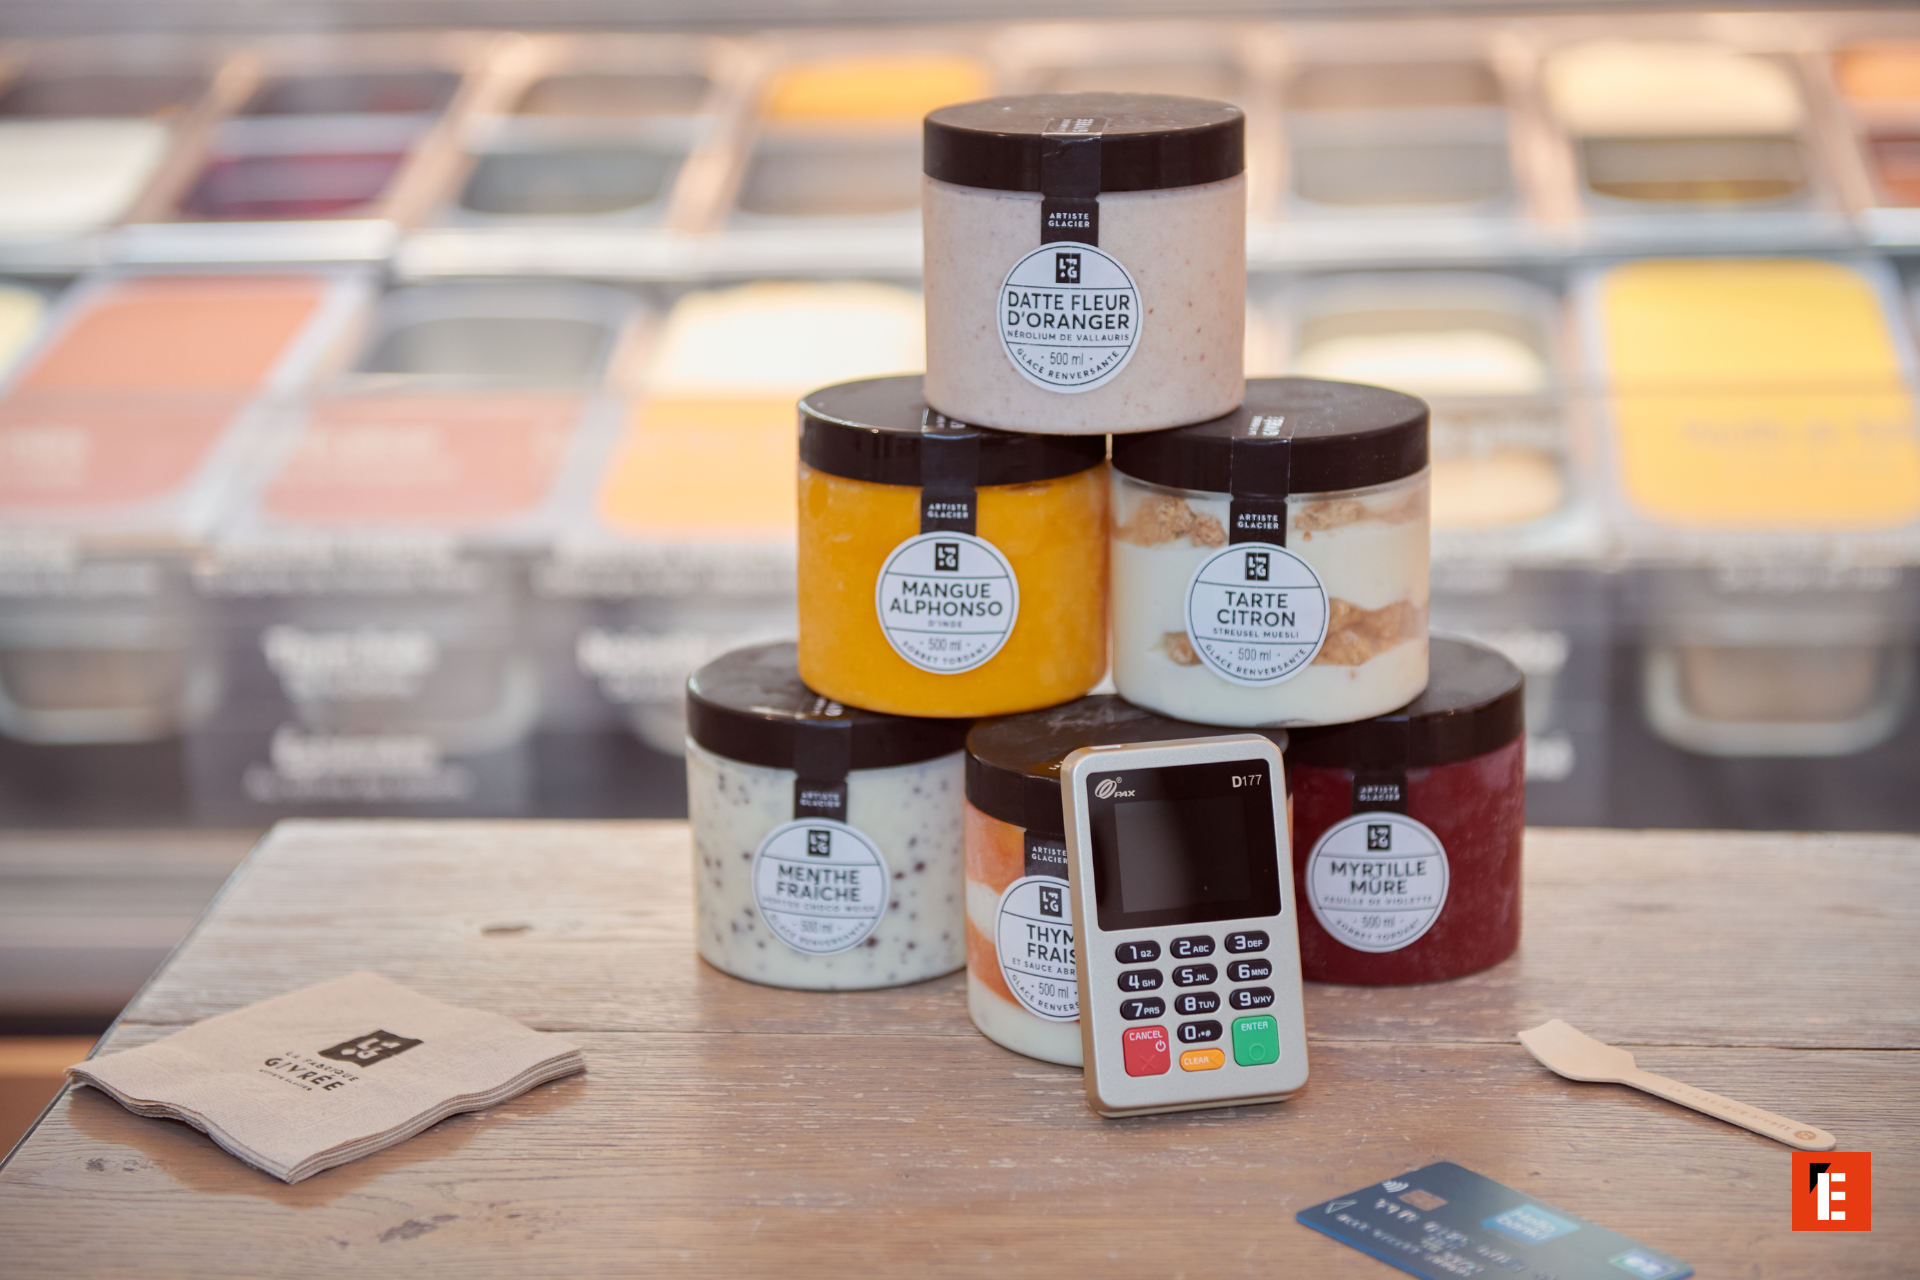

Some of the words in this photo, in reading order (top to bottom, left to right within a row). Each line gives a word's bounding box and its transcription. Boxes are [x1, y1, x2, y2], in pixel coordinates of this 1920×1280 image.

[1050, 212, 1089, 220] ARTISTE
[1048, 220, 1090, 228] GLACIER
[1008, 291, 1064, 310] DATTE
[1071, 294, 1130, 311] FLEUR
[1008, 310, 1130, 330] D'ORANGER
[1007, 330, 1056, 341] NÉROLIUM
[1060, 333, 1072, 341] DE
[1076, 333, 1130, 341] VALLAURIS
[1017, 348, 1045, 374] GLACE
[1047, 350, 1119, 380] RENVERSANTE
[1050, 351, 1068, 365] 500
[1071, 352, 1084, 366] ml
[927, 510, 969, 519] GLACIER
[928, 503, 968, 511] ARTISTE
[1238, 513, 1279, 522] ARTISTE
[1237, 521, 1279, 530] GLACIER
[902, 581, 992, 599] MANGUE
[890, 598, 1003, 617] ALPHONSO
[1225, 591, 1288, 609] TARTE
[1217, 609, 1296, 627] CITRON
[1213, 628, 1259, 638] STREUSEL
[928, 638, 947, 651] 500
[949, 639, 962, 651] ml
[1206, 644, 1232, 669] GLACE
[1237, 648, 1306, 675] RENVERSANTE
[1238, 648, 1257, 661] 500
[1260, 649, 1271, 661] ml
[1232, 774, 1262, 788] D177
[1114, 790, 1136, 798] PAX
[1031, 853, 1068, 864] GLACIER
[1032, 846, 1067, 857] ARTISTE
[778, 864, 859, 884] MENTHE
[1331, 860, 1427, 877] MYRTILLE
[1362, 916, 1381, 928] 500
[1383, 915, 1395, 928] ml
[1179, 941, 1191, 956] 2
[1193, 945, 1209, 953] ABC
[1234, 935, 1246, 950] 3
[1247, 939, 1263, 948] DEF
[1129, 945, 1138, 960] 1
[1012, 957, 1021, 966] ET
[1024, 961, 1053, 973] SAUCE
[1238, 964, 1250, 979] 6
[1251, 968, 1269, 976] MNO
[1128, 974, 1140, 989] 4
[1142, 979, 1156, 987] GHI
[1181, 968, 1194, 984] 5
[1195, 973, 1210, 982] JKL
[1012, 974, 1035, 1002] GLACE
[1038, 982, 1055, 997] 500
[1058, 986, 1069, 999] ml
[1184, 996, 1196, 1012] 8
[1198, 1000, 1215, 1009] TUV
[1239, 992, 1252, 1007] 9
[1252, 995, 1272, 1004] WXY
[1131, 1002, 1143, 1018] 7
[1144, 1006, 1160, 1015] PRS
[1184, 1025, 1197, 1040] 0
[1241, 1021, 1269, 1031] ENTER
[1129, 1030, 1163, 1042] CANCEL
[1184, 1056, 1209, 1066] CLEAR
[264, 1057, 345, 1091] GIVRÉE
[303, 1058, 359, 1082] FABRIQUE
